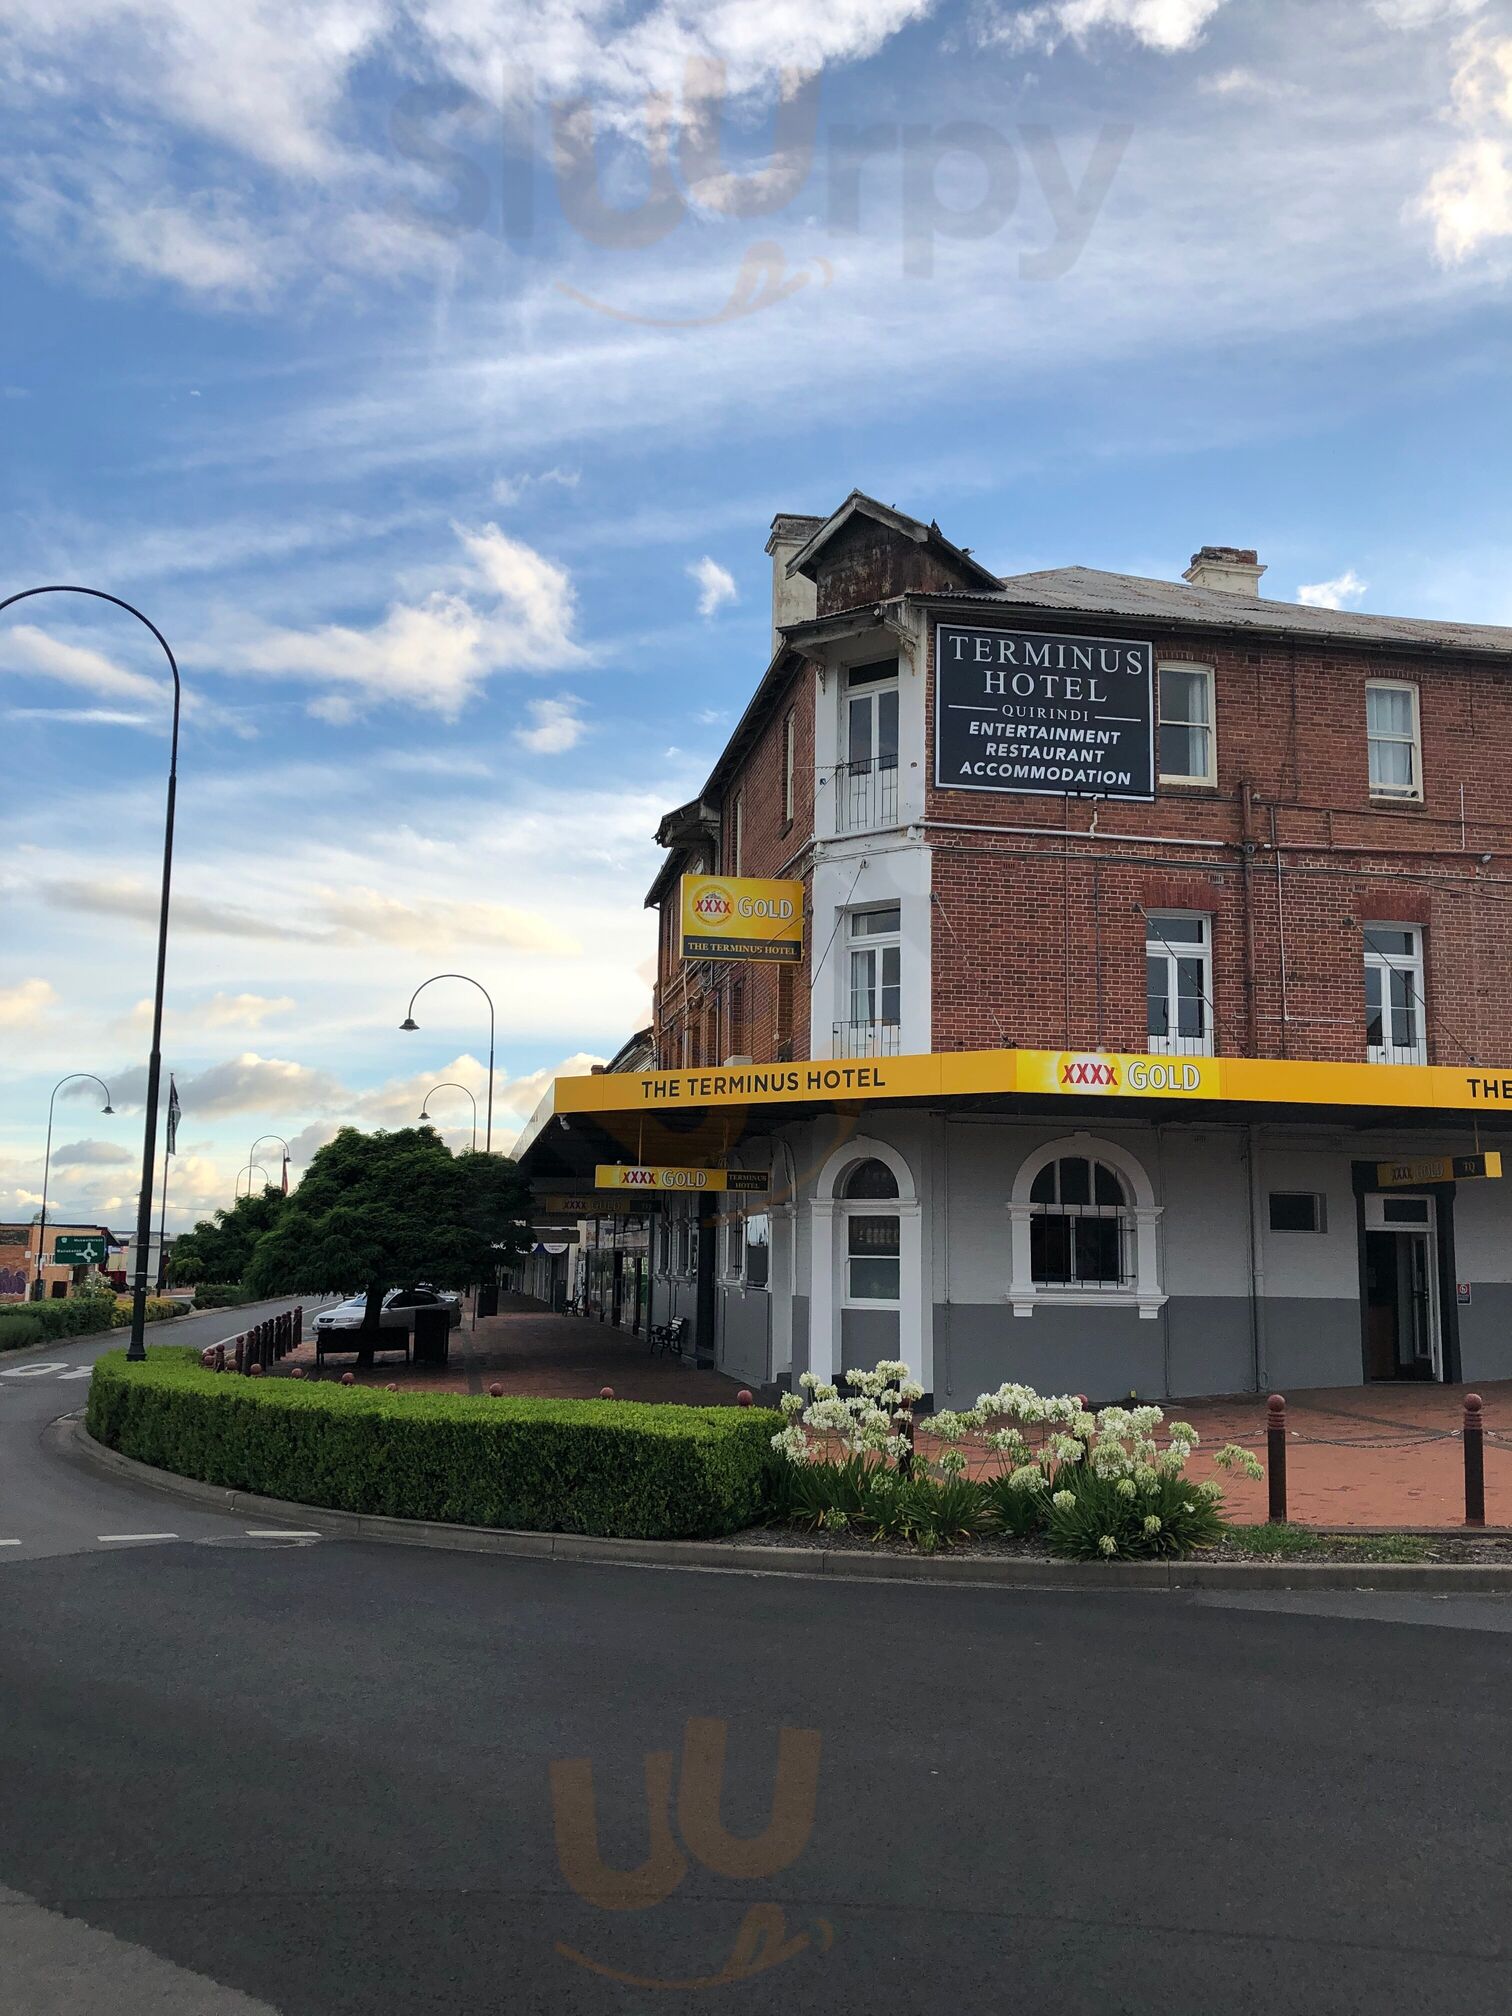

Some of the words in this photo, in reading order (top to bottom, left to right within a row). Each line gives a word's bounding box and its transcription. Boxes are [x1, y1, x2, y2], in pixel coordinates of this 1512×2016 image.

[948, 635, 1144, 675] TERMINUS
[983, 670, 1108, 702] HOTEL
[1001, 704, 1089, 722] QUIRINDI
[969, 721, 1121, 745] ENTERTAINMENT
[985, 742, 1105, 763] RESTAURANT
[959, 761, 1131, 785] ACCOMMODATION
[695, 899, 732, 914] XXXX
[737, 895, 794, 919] GOLD
[687, 942, 709, 951] THE
[710, 943, 763, 954] TERMINUS
[765, 946, 798, 956] HOTEL
[641, 1079, 680, 1099] THE
[687, 1072, 799, 1096] TERMINUS
[806, 1067, 886, 1090] HOTEL
[1061, 1063, 1119, 1086] XXXX
[1127, 1061, 1201, 1091] GOLD
[1466, 1079, 1512, 1099] THE
[621, 1171, 657, 1185] XXXX
[661, 1170, 708, 1188] GOLD
[728, 1174, 767, 1182] TERMINUS
[735, 1182, 760, 1190] HOTEL
